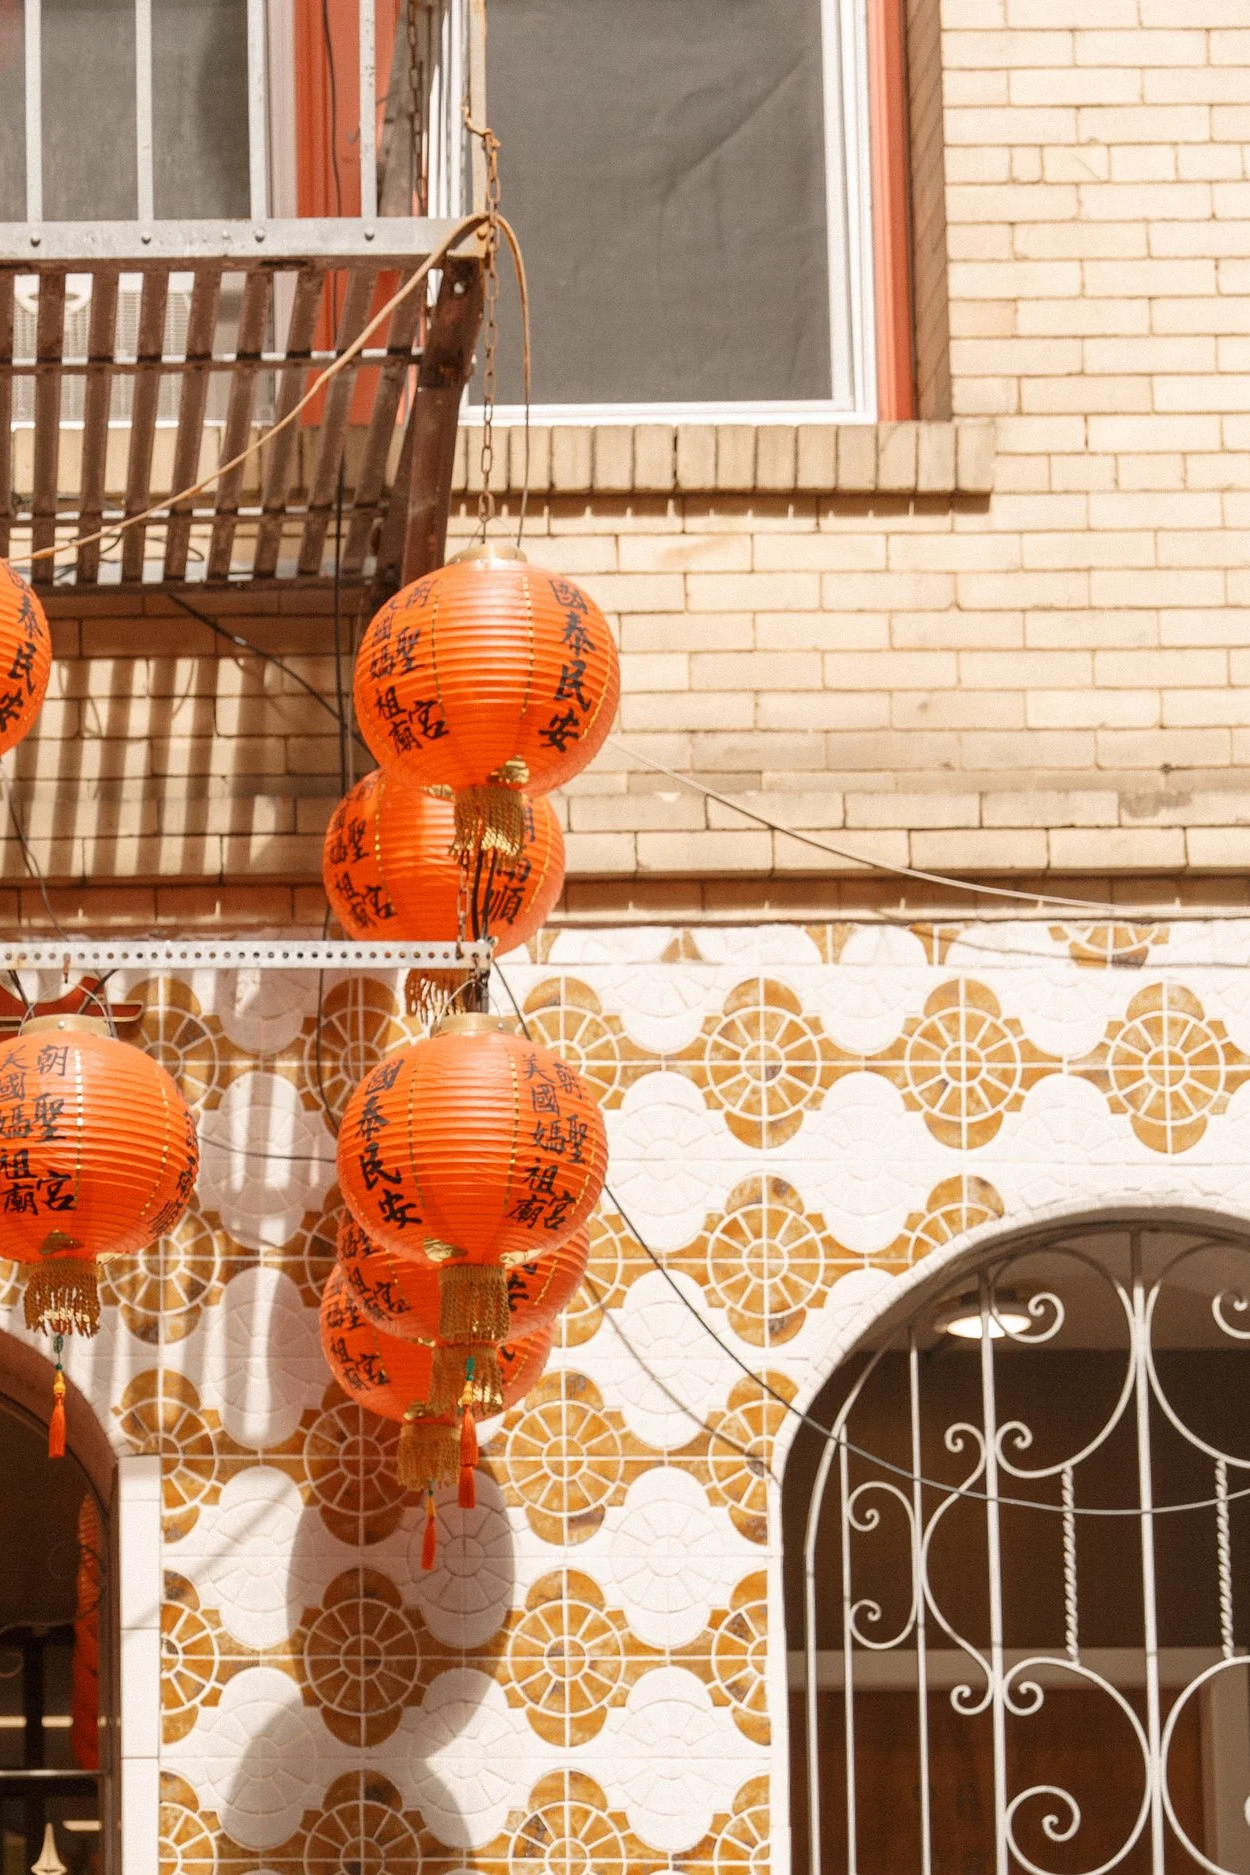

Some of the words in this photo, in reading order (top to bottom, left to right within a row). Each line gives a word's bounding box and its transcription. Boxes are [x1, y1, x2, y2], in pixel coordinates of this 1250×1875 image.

[538, 579, 598, 752] 國泰民安
[32, 1045, 77, 1212] 朝聖宮
[356, 1059, 422, 1230] 國泰民安
[507, 1053, 566, 1230] 美國媽祖廟
[544, 1062, 588, 1231] 朝聖宮
